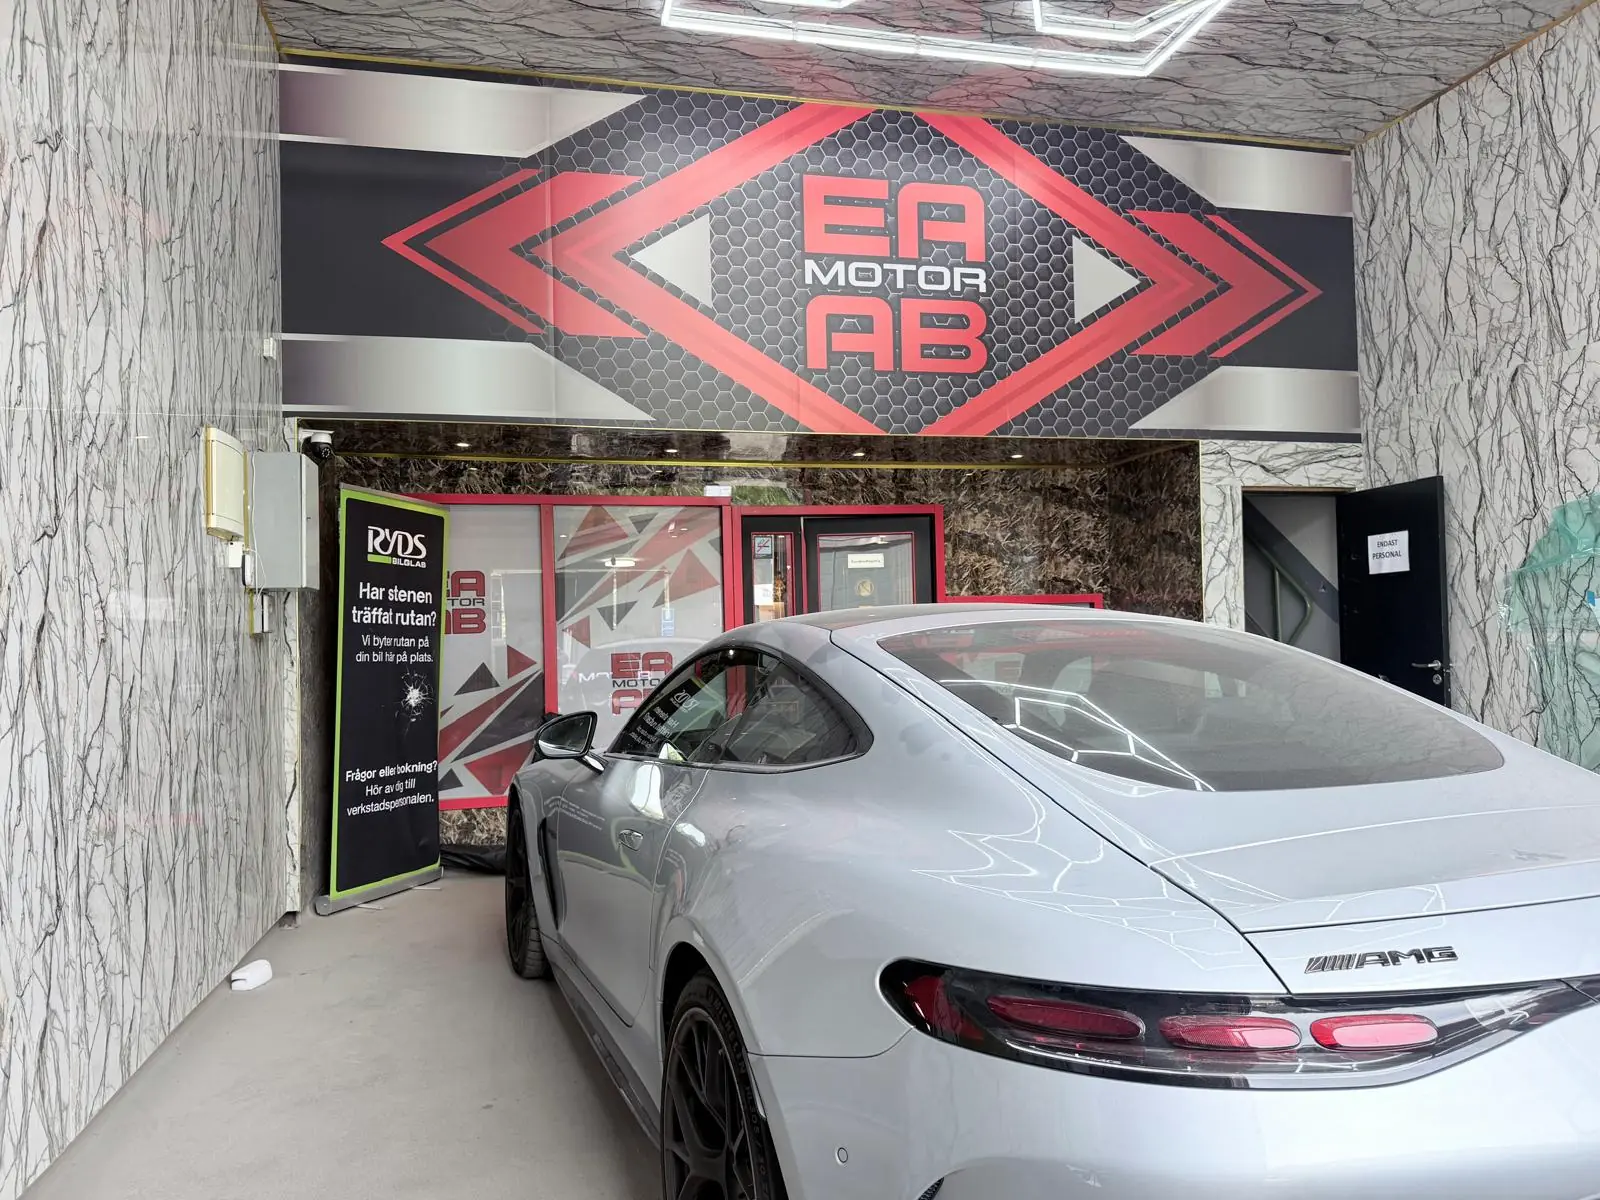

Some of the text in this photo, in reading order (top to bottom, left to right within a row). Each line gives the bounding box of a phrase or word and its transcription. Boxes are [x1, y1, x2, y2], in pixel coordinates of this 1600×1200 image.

[802, 174, 986, 262] EA
[804, 259, 987, 293] MOTOR
[806, 294, 988, 374] AB
[367, 525, 427, 559] RYDS
[1376, 539, 1398, 548] ENDAST
[392, 557, 427, 568] BILGLAS
[1372, 550, 1402, 560] PERSONAL
[359, 581, 433, 604] Har stenen
[446, 570, 485, 597] A
[446, 598, 485, 607] TOR
[352, 605, 437, 627] träffat rutan?
[361, 634, 430, 650] Vi byter rutan på
[355, 651, 434, 665] din bil här på plats.
[611, 651, 673, 680] EA
[612, 679, 661, 688] MOTO
[611, 688, 652, 715] A
[345, 760, 438, 783] Frågor eller bokning?
[365, 784, 382, 797] Hör
[384, 784, 394, 794] av
[405, 778, 416, 789] till
[346, 793, 435, 817] verkstadspersonalen.
[1354, 945, 1459, 969] AMG
